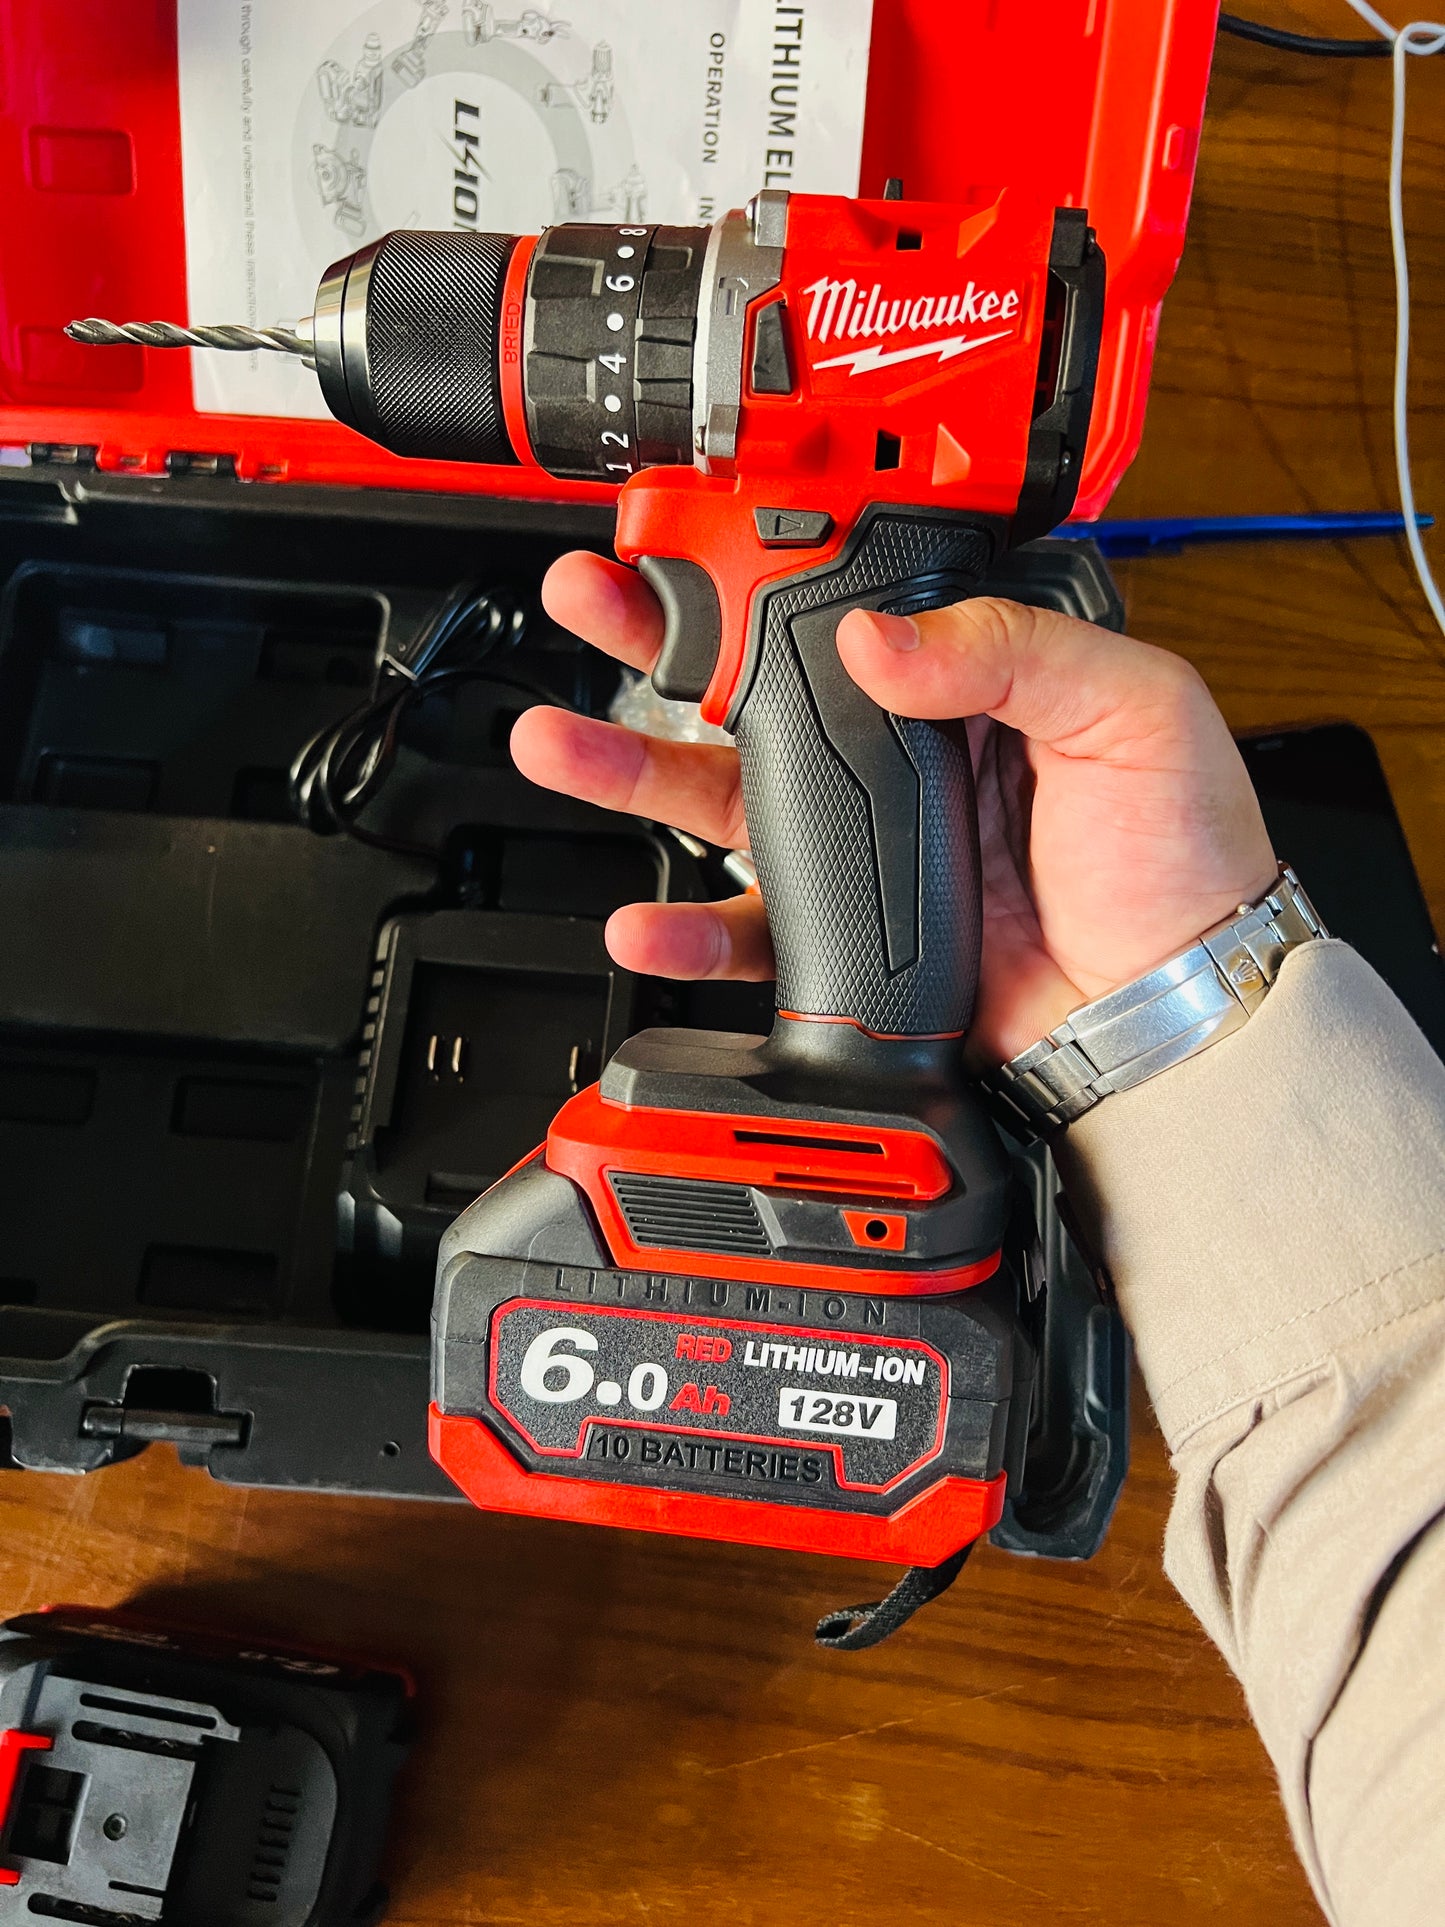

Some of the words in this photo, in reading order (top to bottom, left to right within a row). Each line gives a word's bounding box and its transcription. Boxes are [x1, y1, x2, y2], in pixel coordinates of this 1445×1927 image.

[239, 4, 254, 55] through
[240, 58, 254, 113] carefully
[768, 0, 804, 137] ITHIUM
[702, 32, 725, 164] OPERATION
[242, 116, 255, 142] and
[243, 145, 257, 217] understand
[764, 149, 794, 188] EL
[619, 227, 648, 237] 8
[699, 196, 714, 225] IN
[605, 275, 635, 292] 6
[803, 276, 1019, 344] Milwaukee
[598, 352, 628, 374] 4
[601, 431, 630, 449] 2
[555, 1269, 887, 1327] LITHIUM-ION
[520, 1327, 669, 1412] 6.0
[669, 1382, 732, 1417] Ah
[675, 1333, 733, 1363] RED
[744, 1341, 927, 1386] LITHIUM-ION
[790, 1395, 886, 1430] 128V
[596, 1433, 631, 1461] 10
[641, 1440, 823, 1483] BATTERIES
